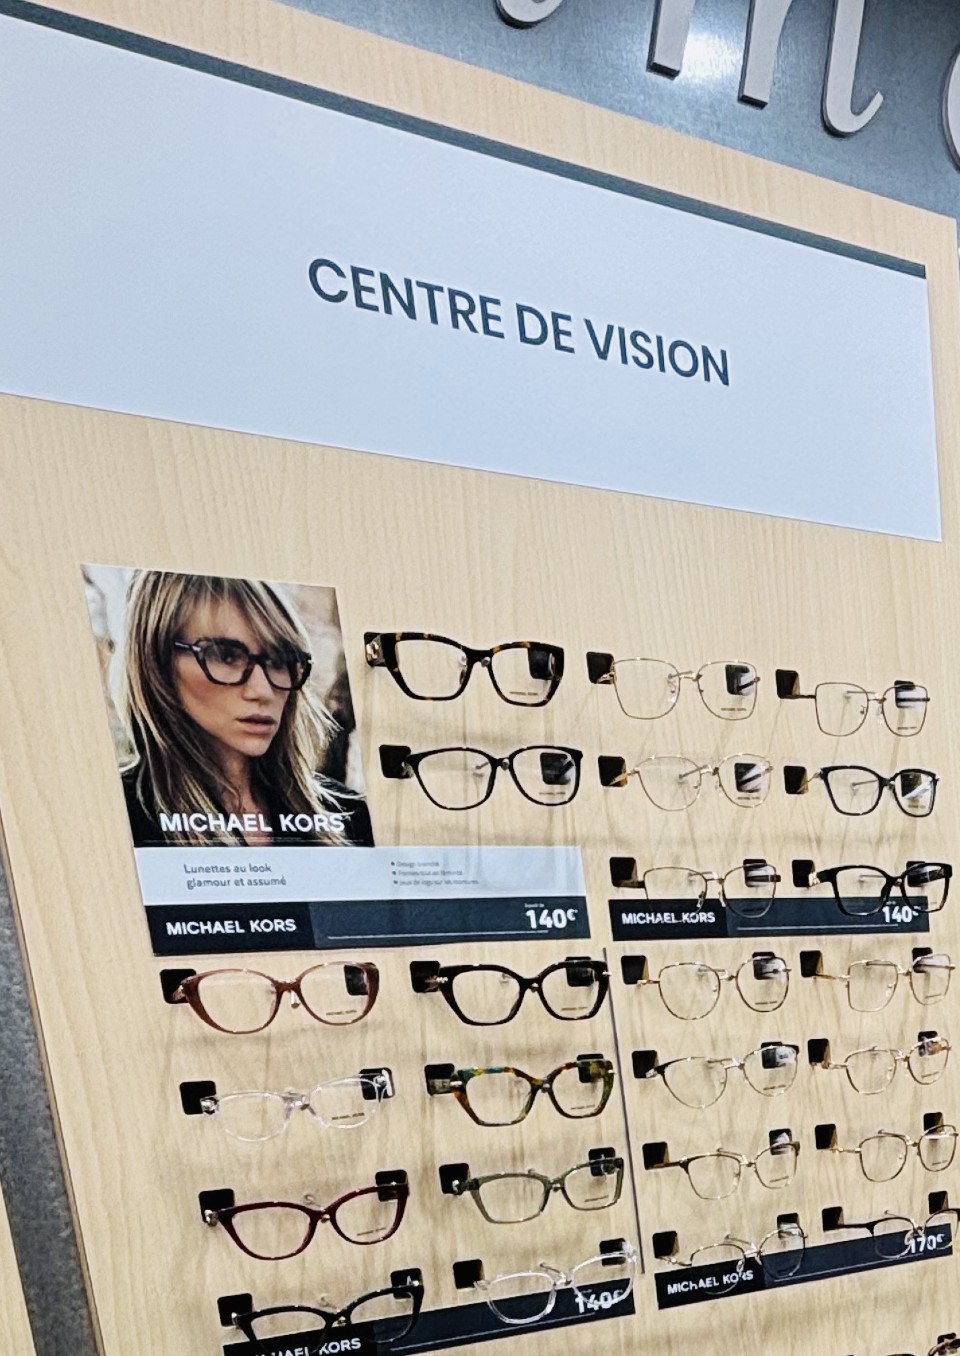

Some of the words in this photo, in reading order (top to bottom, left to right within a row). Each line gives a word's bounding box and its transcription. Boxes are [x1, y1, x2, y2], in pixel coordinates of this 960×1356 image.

[308, 258, 505, 339] CENTRE
[515, 302, 576, 354] DE
[584, 318, 730, 386] VISION
[159, 812, 273, 832] MICHAEL
[279, 812, 346, 832] KORS
[184, 863, 231, 874] Lunettes
[233, 865, 247, 873] au
[249, 863, 272, 873] look
[186, 877, 231, 890] glamour
[234, 877, 245, 887] et
[248, 876, 287, 887] assumé
[621, 912, 678, 925] MICHAEL
[681, 911, 716, 923] KORS
[165, 920, 246, 935] MICHAEL
[250, 918, 297, 933] KORS
